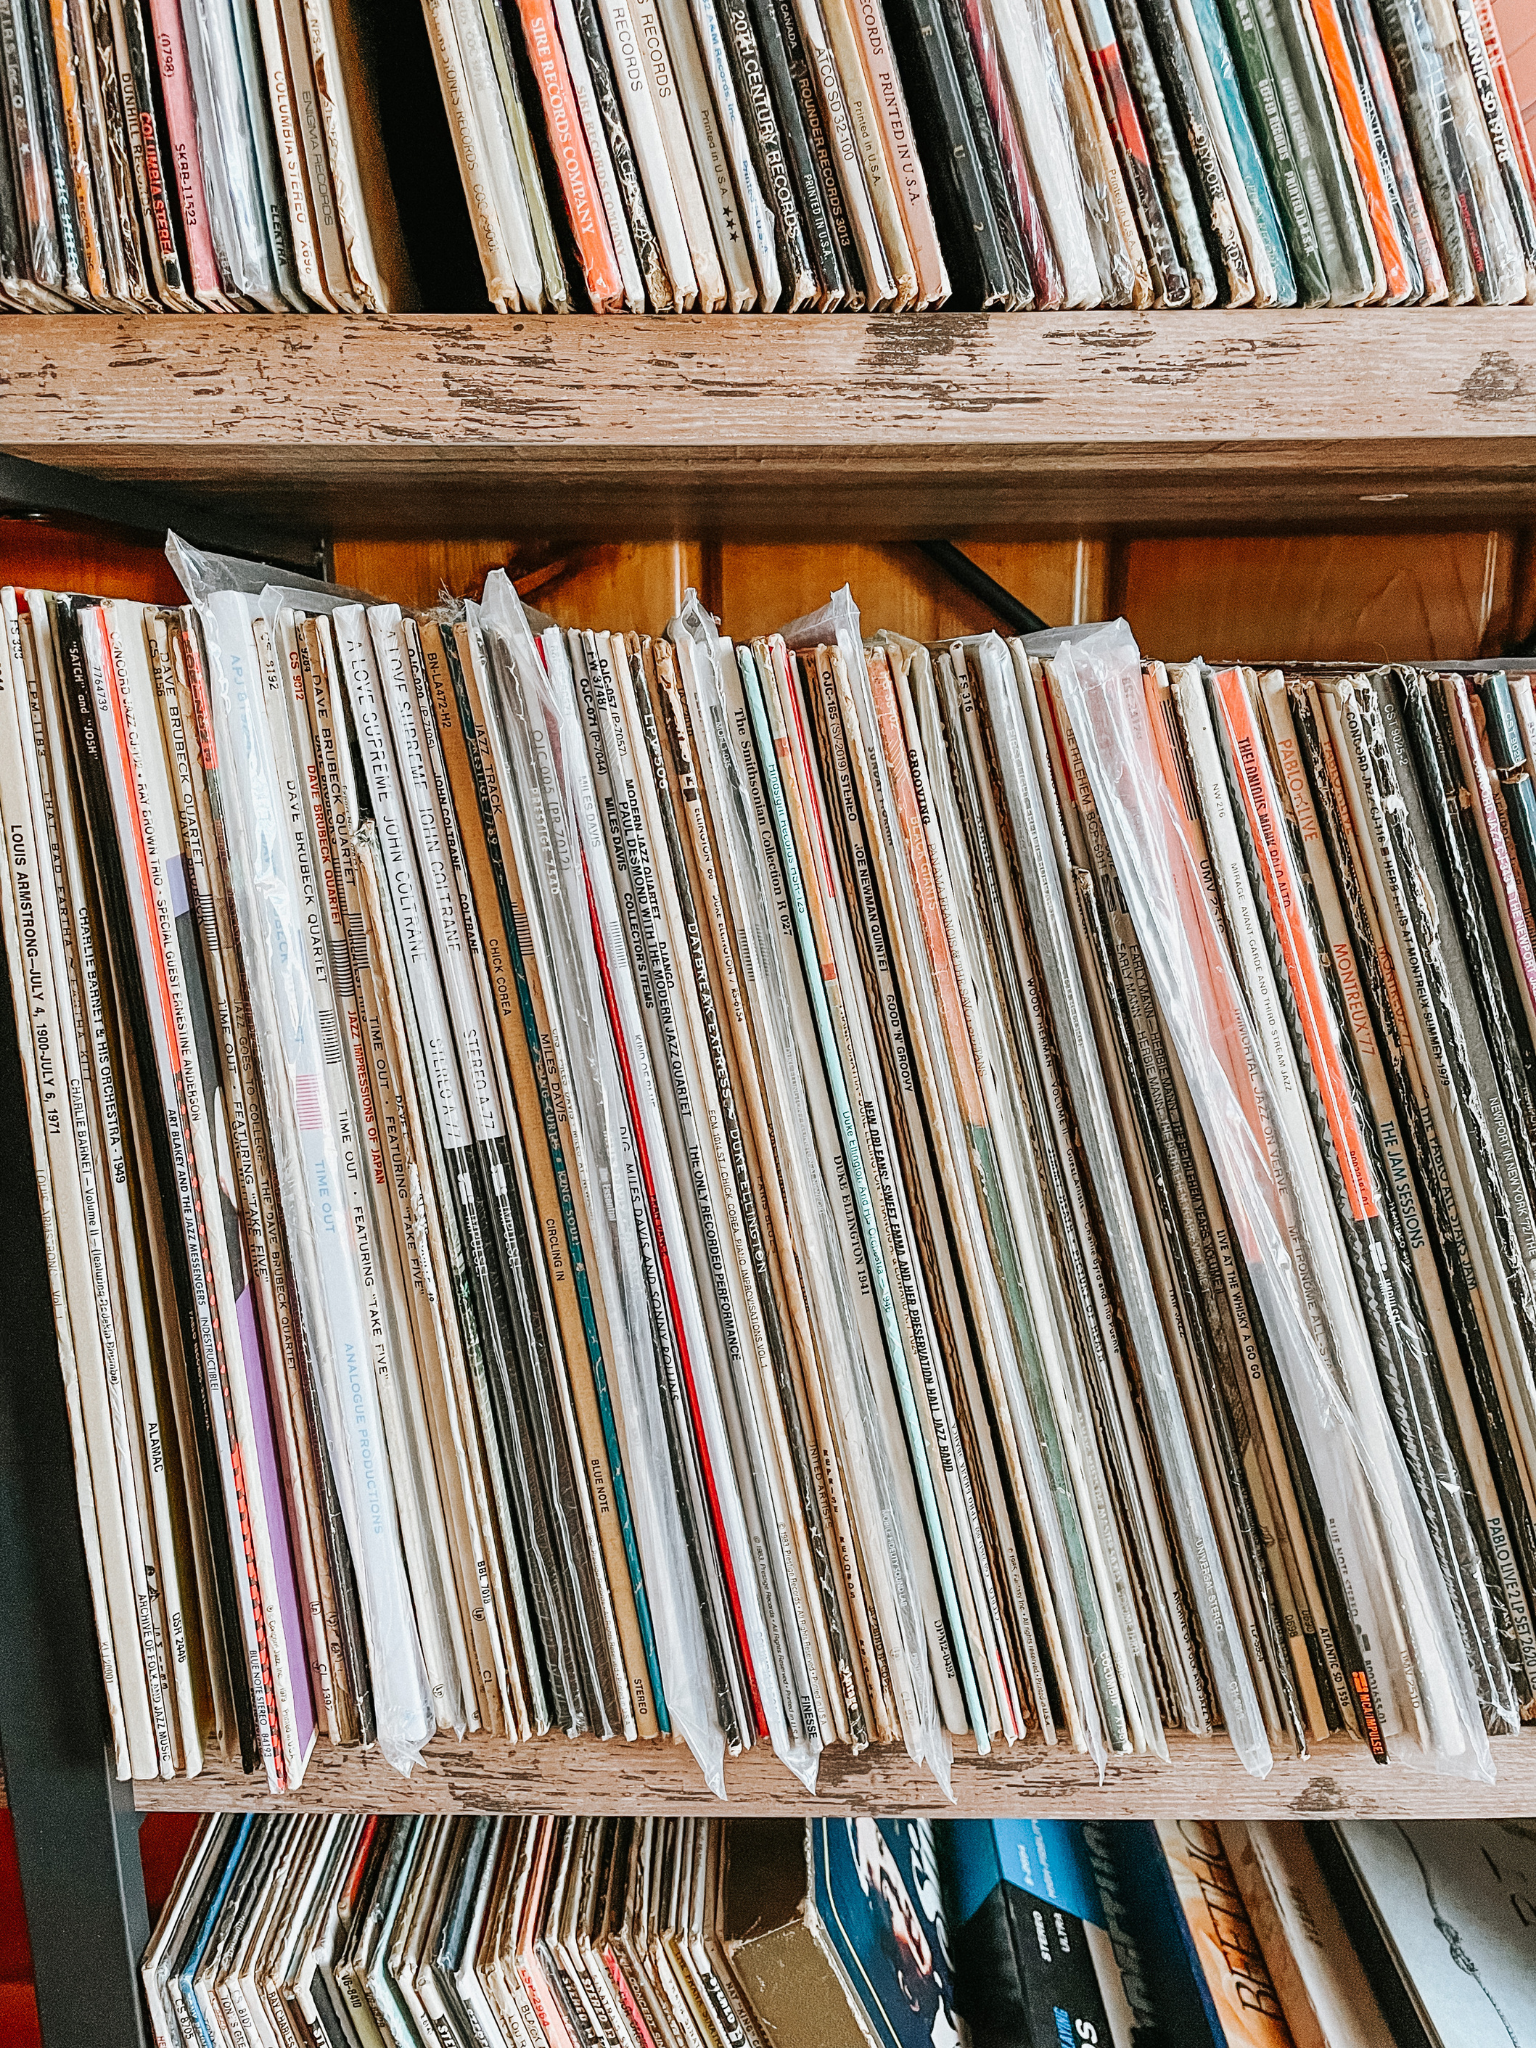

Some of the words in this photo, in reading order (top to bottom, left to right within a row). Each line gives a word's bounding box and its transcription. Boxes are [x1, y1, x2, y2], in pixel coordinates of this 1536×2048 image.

[612, 6, 643, 92] RECORDS
[641, 13, 671, 98] RECORDS
[814, 46, 834, 87] ATCO
[1456, 7, 1490, 90] ATLANTIC
[121, 72, 139, 138] DUNHILL
[826, 91, 841, 112] SD
[853, 101, 870, 138] Printed
[878, 72, 904, 140] PRINTED
[1479, 91, 1497, 115] SD
[527, 13, 550, 56] SIRE
[539, 59, 572, 142] RECORDS
[560, 145, 594, 235] COMPANY
[730, 9, 755, 55] 20TH
[743, 58, 777, 146] CENTURY
[766, 150, 800, 239] RECORDS
[832, 114, 854, 161] 32-100
[1486, 116, 1511, 162] 19128
[139, 111, 162, 194] COLUMBIA
[272, 70, 295, 155] COLUMBIA
[287, 161, 307, 224] STEREO
[301, 91, 319, 149] ENIGMA
[312, 152, 333, 225] RECORDS
[798, 78, 824, 146] ROUNDER
[816, 148, 842, 215] RECORDS
[834, 218, 850, 246] 3013
[862, 140, 873, 151] in
[895, 142, 909, 160] IN
[1257, 79, 1276, 115] GEFFEN
[1267, 116, 1288, 161] RECORDS
[1283, 171, 1302, 211] PRINTED
[1294, 212, 1306, 224] IN
[866, 153, 882, 186] U.S.A.
[901, 164, 921, 206] U.S.A.
[803, 173, 821, 214] PRINTED
[269, 204, 287, 265] ELEKTRA
[813, 217, 824, 229] IN
[817, 231, 832, 260] U.S.A.
[287, 651, 299, 669] CS
[76, 693, 90, 714] and
[92, 665, 108, 711] 7764739
[291, 673, 304, 700] 9012
[427, 652, 452, 728] BN-LA472-H2
[733, 707, 749, 735] The
[306, 764, 321, 802] DAVE
[740, 739, 768, 825] Smithsonian
[1278, 739, 1305, 794] PABLO
[312, 803, 331, 864] BRUBECK
[618, 801, 635, 835] PAUL
[1296, 806, 1317, 842] LIVE
[10, 824, 26, 866] LOUIS
[759, 829, 783, 896] Collection
[625, 837, 649, 905] DESMOND
[323, 869, 341, 927] QUARTET
[775, 899, 786, 911] R
[77, 907, 95, 967] CHARLIE
[639, 907, 656, 939] WITH
[778, 914, 792, 937] 027
[485, 938, 503, 974] CHICK
[646, 941, 661, 965] THE
[32, 1006, 45, 1017] 4,
[86, 969, 103, 1024] BARNET
[493, 976, 511, 1016] COREA
[652, 967, 673, 1024] MODERN
[347, 1009, 360, 1041] JAZZ
[663, 1026, 679, 1057] JAZZ
[35, 1023, 54, 1086] 1900-JULY
[96, 1041, 108, 1063] HIS
[44, 1092, 56, 1102] 6,
[353, 1043, 374, 1122] IMPRESSIONS
[670, 1060, 691, 1117] QUARTET
[686, 922, 714, 1015] DAYBREAK
[706, 1021, 731, 1098] EXPRESS
[728, 1128, 747, 1172] DUKE
[739, 1180, 767, 1273] ELLINGTON
[46, 1108, 60, 1134] 1971
[99, 1065, 120, 1145] ORCHESTRA
[166, 1108, 178, 1128] ART
[863, 1100, 877, 1126] NEW
[1487, 1096, 1510, 1148] NEWPORT
[169, 1129, 184, 1168] BLAKEY
[367, 1127, 378, 1143] OF
[1379, 1120, 1398, 1148] THE
[112, 1155, 125, 1184] 1949
[370, 1147, 385, 1184] JAPAN
[688, 1145, 701, 1167] THE
[869, 1129, 889, 1181] ORLEANS'
[1387, 1149, 1407, 1181] JAM
[1501, 1149, 1513, 1161] IN
[1504, 1161, 1519, 1186] NEW
[176, 1170, 188, 1193] AND
[314, 1159, 330, 1198] TIME
[693, 1170, 708, 1202] ONLY
[179, 1195, 191, 1214] THE
[320, 1202, 335, 1234] OUT
[881, 1184, 898, 1220] SWEET
[1395, 1183, 1424, 1249] SESSIONS
[1510, 1185, 1527, 1216] YORK
[183, 1217, 196, 1240] JAZZ
[545, 1218, 562, 1268] CIRCLING
[700, 1204, 722, 1271] RECORDED
[831, 1155, 849, 1191] DUKE
[840, 1194, 864, 1266] ELLINGTON
[855, 1269, 870, 1296] 1941
[889, 1222, 906, 1258] EMMA
[1215, 1229, 1229, 1251] LIVE
[187, 1243, 206, 1306] MESSENGERS
[554, 1270, 565, 1281] IN
[898, 1260, 911, 1282] AND
[1221, 1254, 1233, 1268] AT
[1225, 1270, 1239, 1289] THE
[903, 1284, 917, 1306] HER
[1231, 1292, 1249, 1330] WHISKY
[713, 1272, 740, 1361] PERFORMANCE
[908, 1309, 934, 1386] PRESERVATION
[1241, 1332, 1251, 1341] A
[1244, 1344, 1256, 1361] GO
[343, 1342, 366, 1423] ANALOGUE
[1248, 1363, 1261, 1380] GO
[925, 1387, 940, 1413] HALL
[147, 1422, 162, 1473] ALAMAC
[931, 1416, 947, 1443] JAZZ
[938, 1445, 953, 1473] BAND
[357, 1428, 384, 1535] PRODUCTIONS
[248, 1649, 260, 1670] BLUE
[251, 1672, 263, 1695] NOTE
[255, 1696, 268, 1726] STEREO
[800, 1695, 817, 1739] FINESSE
[260, 1732, 272, 1757] 84193
[1032, 1910, 1051, 1962] STEREO
[1053, 1912, 1071, 1953] ULTRA
[267, 1991, 279, 2009] RAY
[340, 1974, 361, 2009] V6-8410
[520, 1968, 550, 2027] LSP-2964
[581, 1975, 608, 2023] STEREO
[628, 1976, 656, 2029] CONCERT
[725, 1981, 740, 2003] NAT
[174, 1998, 186, 2015] CS
[181, 2016, 195, 2040] 8705
[520, 2004, 542, 2042] BLACK
